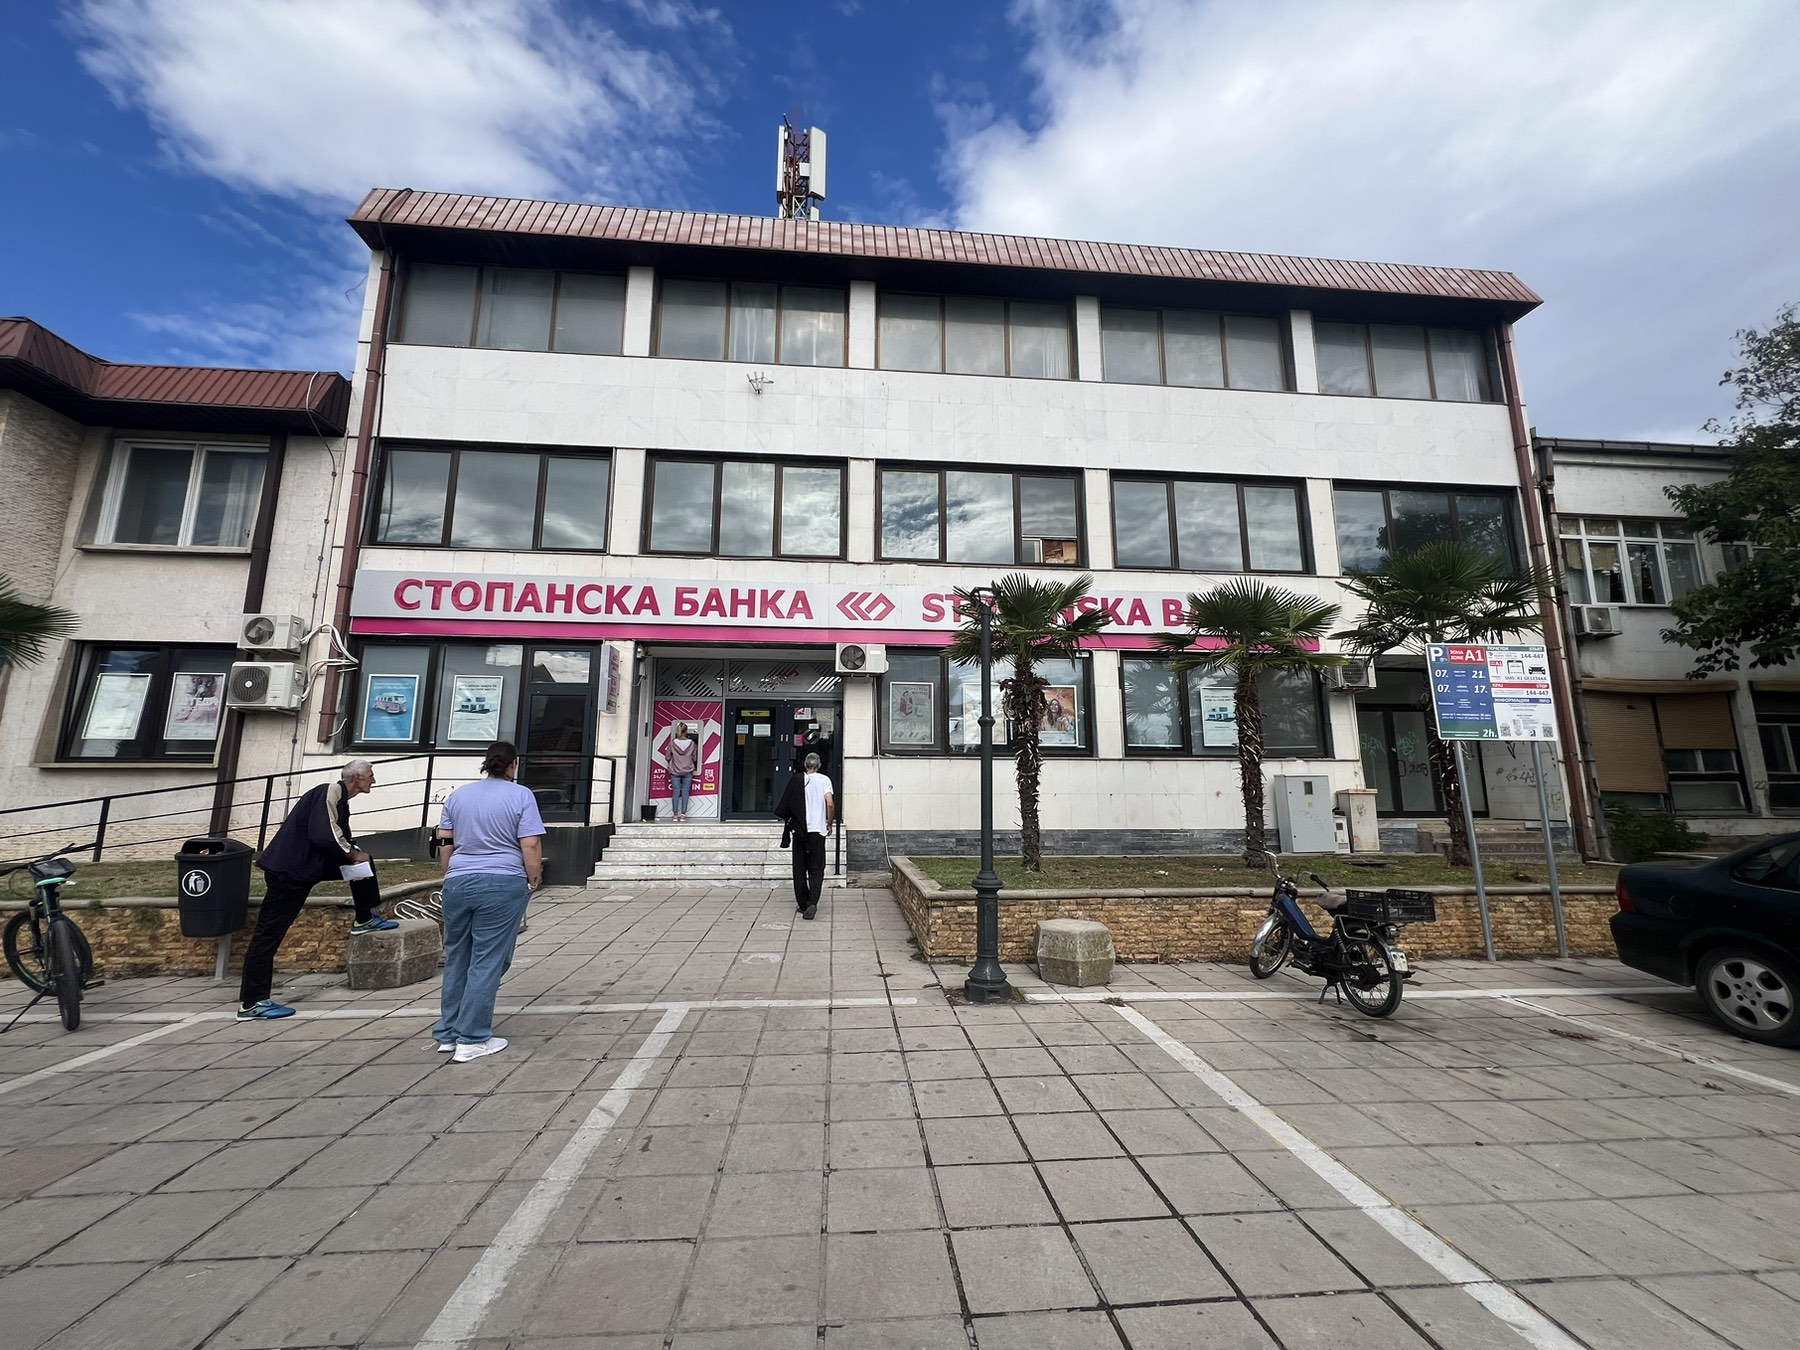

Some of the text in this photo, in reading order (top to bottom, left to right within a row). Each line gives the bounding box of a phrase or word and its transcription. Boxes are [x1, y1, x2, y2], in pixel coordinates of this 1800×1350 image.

[394, 578, 815, 621] СТОПАНСКА БАНКА
[1430, 647, 1443, 662] P
[1465, 649, 1484, 662] A1
